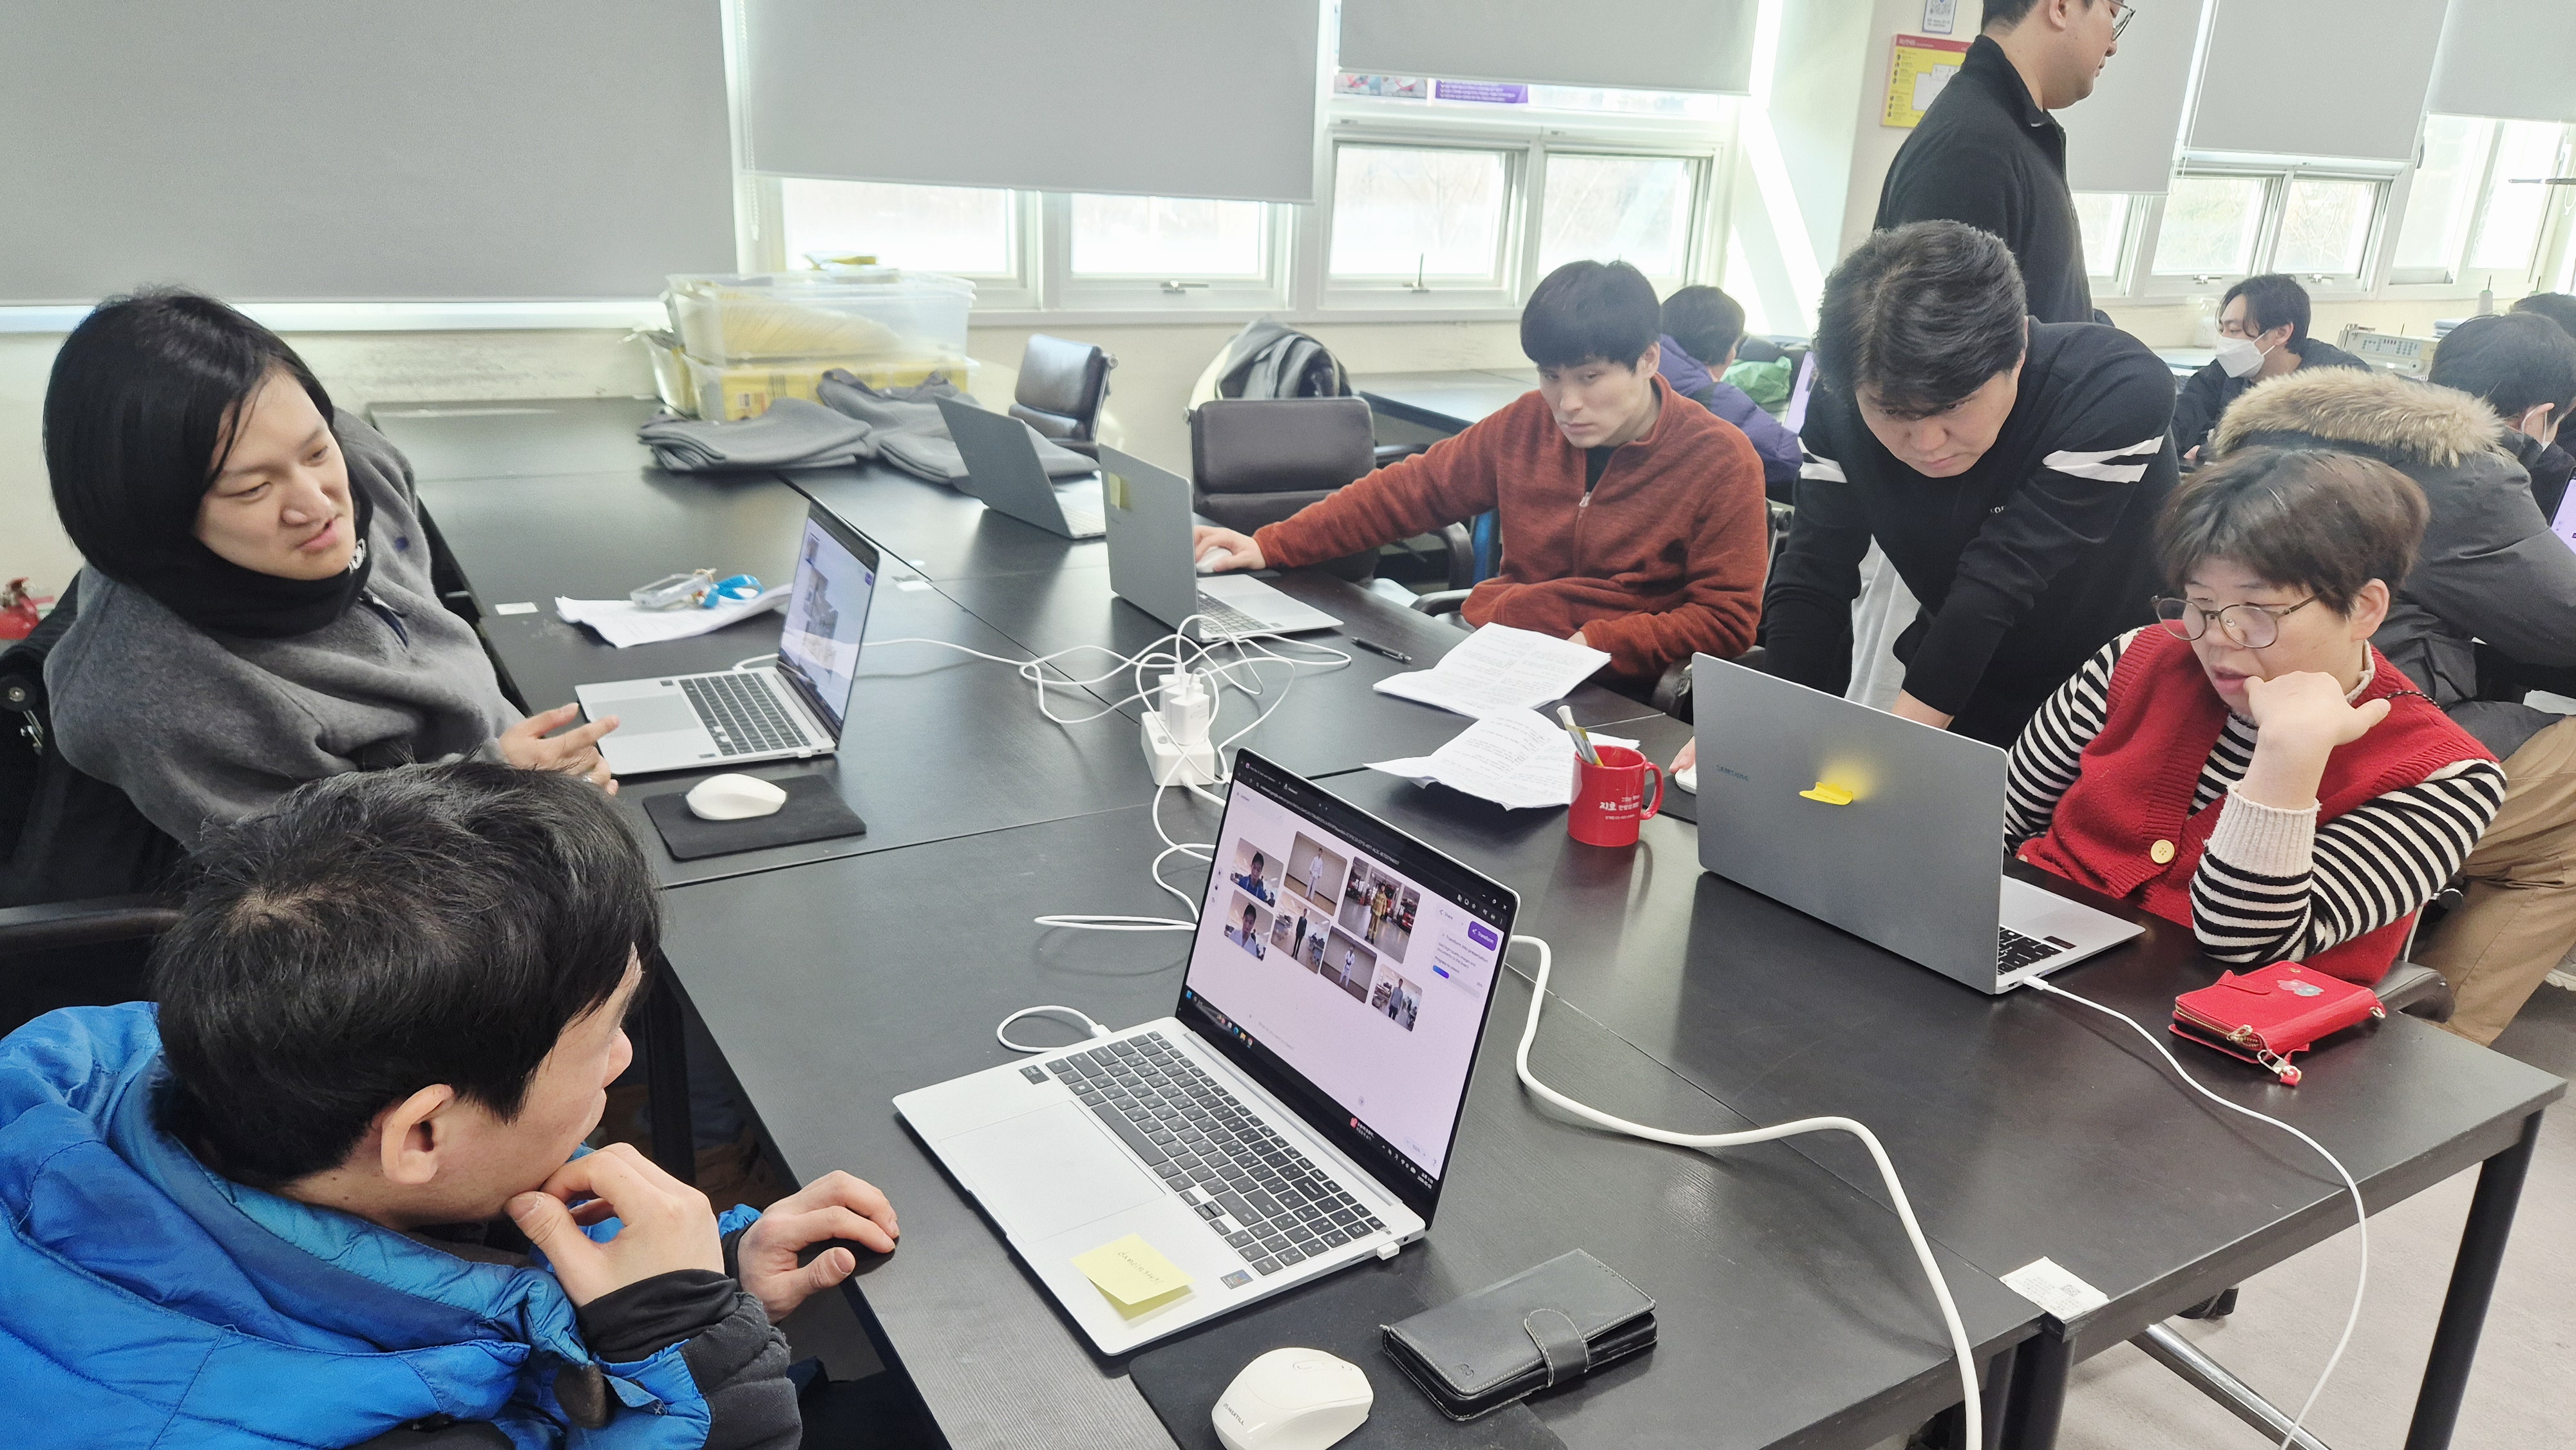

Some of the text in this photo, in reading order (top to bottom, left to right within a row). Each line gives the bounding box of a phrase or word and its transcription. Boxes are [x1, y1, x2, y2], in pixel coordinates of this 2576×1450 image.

[1599, 802, 1616, 811] 지호
[1478, 932, 1493, 943] Transform
[1446, 935, 1461, 946] Transform
[1468, 950, 1488, 962] presentation
[1227, 1407, 1244, 1426] MAXTILL
